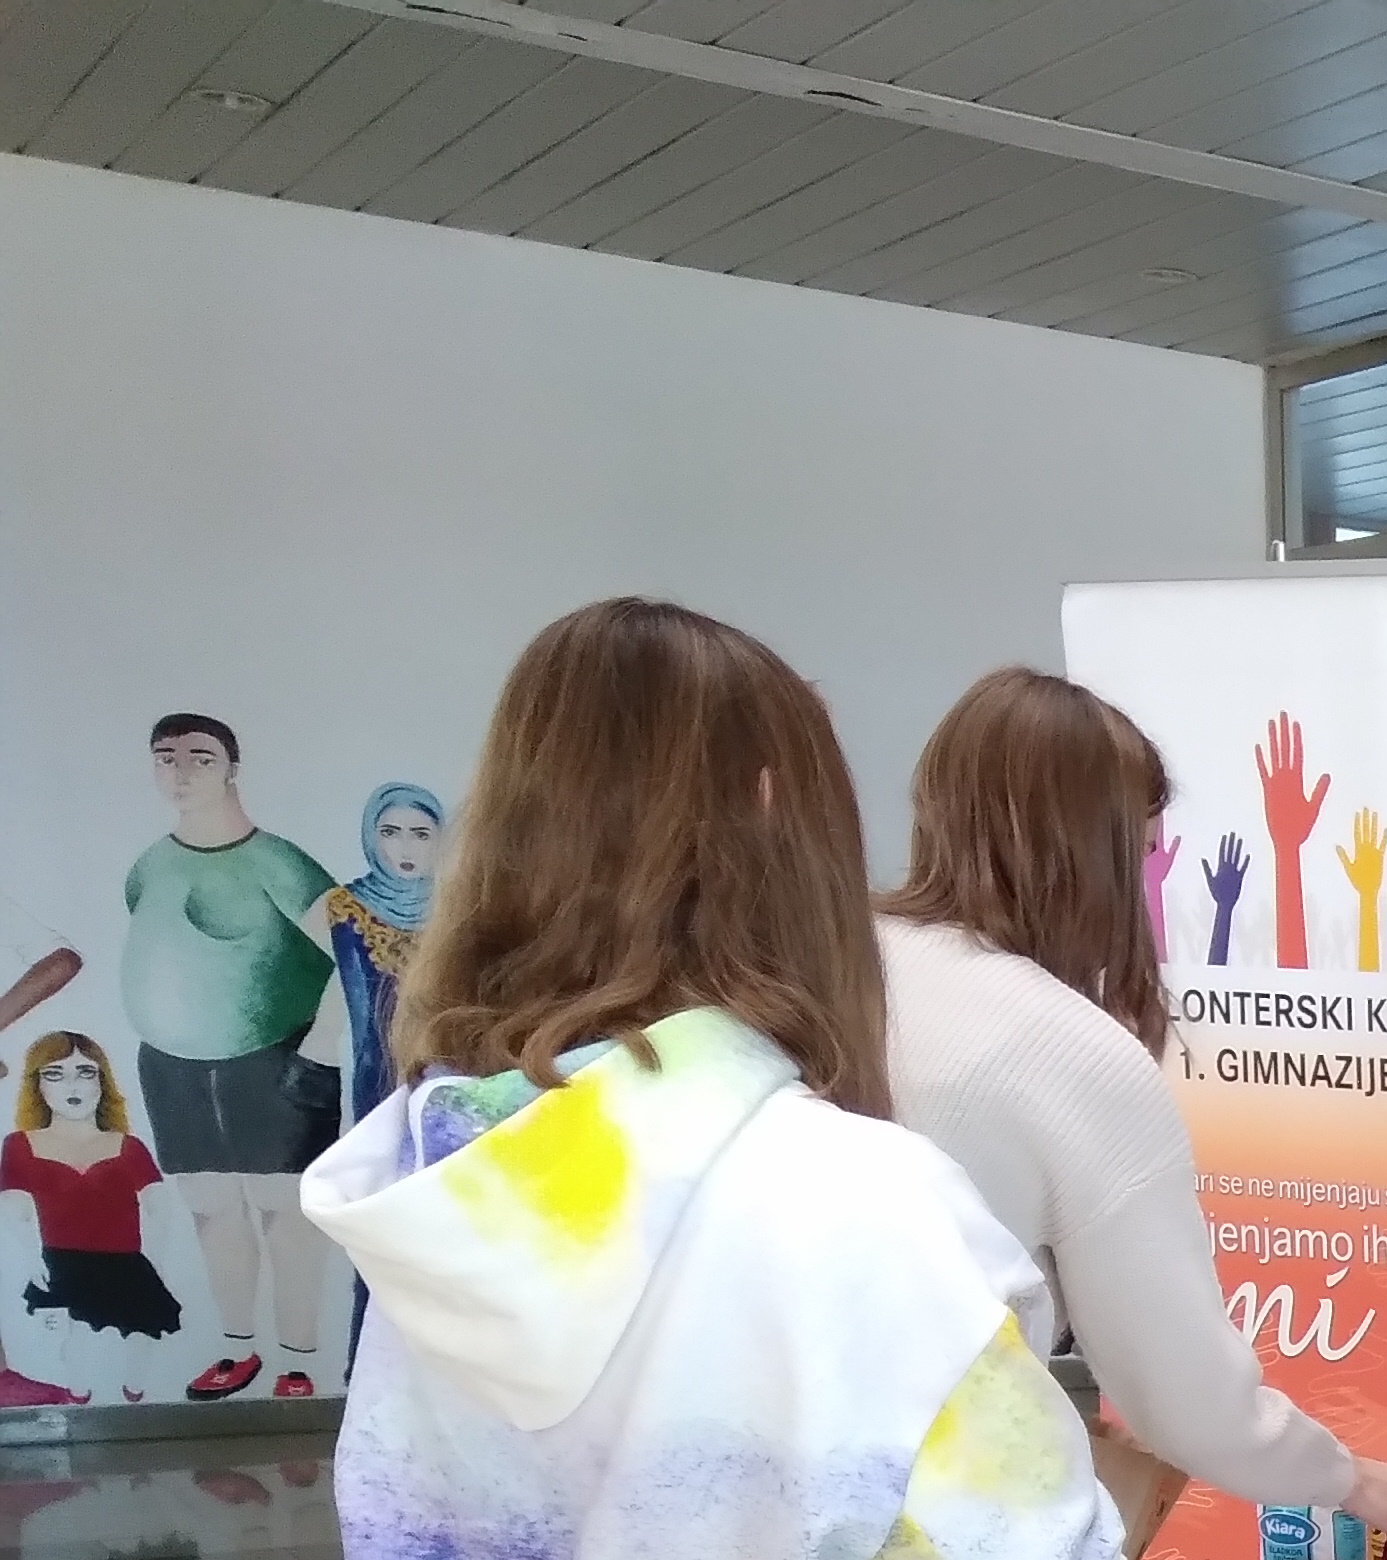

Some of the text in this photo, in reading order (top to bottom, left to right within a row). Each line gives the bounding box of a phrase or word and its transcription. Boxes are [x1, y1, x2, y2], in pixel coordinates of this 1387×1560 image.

[1168, 988, 1354, 1032] LONTERSKI
[1193, 1172, 1214, 1193] ari
[1219, 1175, 1243, 1195] se
[1248, 1176, 1274, 1197] ne
[1279, 1176, 1381, 1211] mijenjaju
[1207, 1211, 1354, 1264] jenjamo
[1264, 1517, 1306, 1541] Kiara
